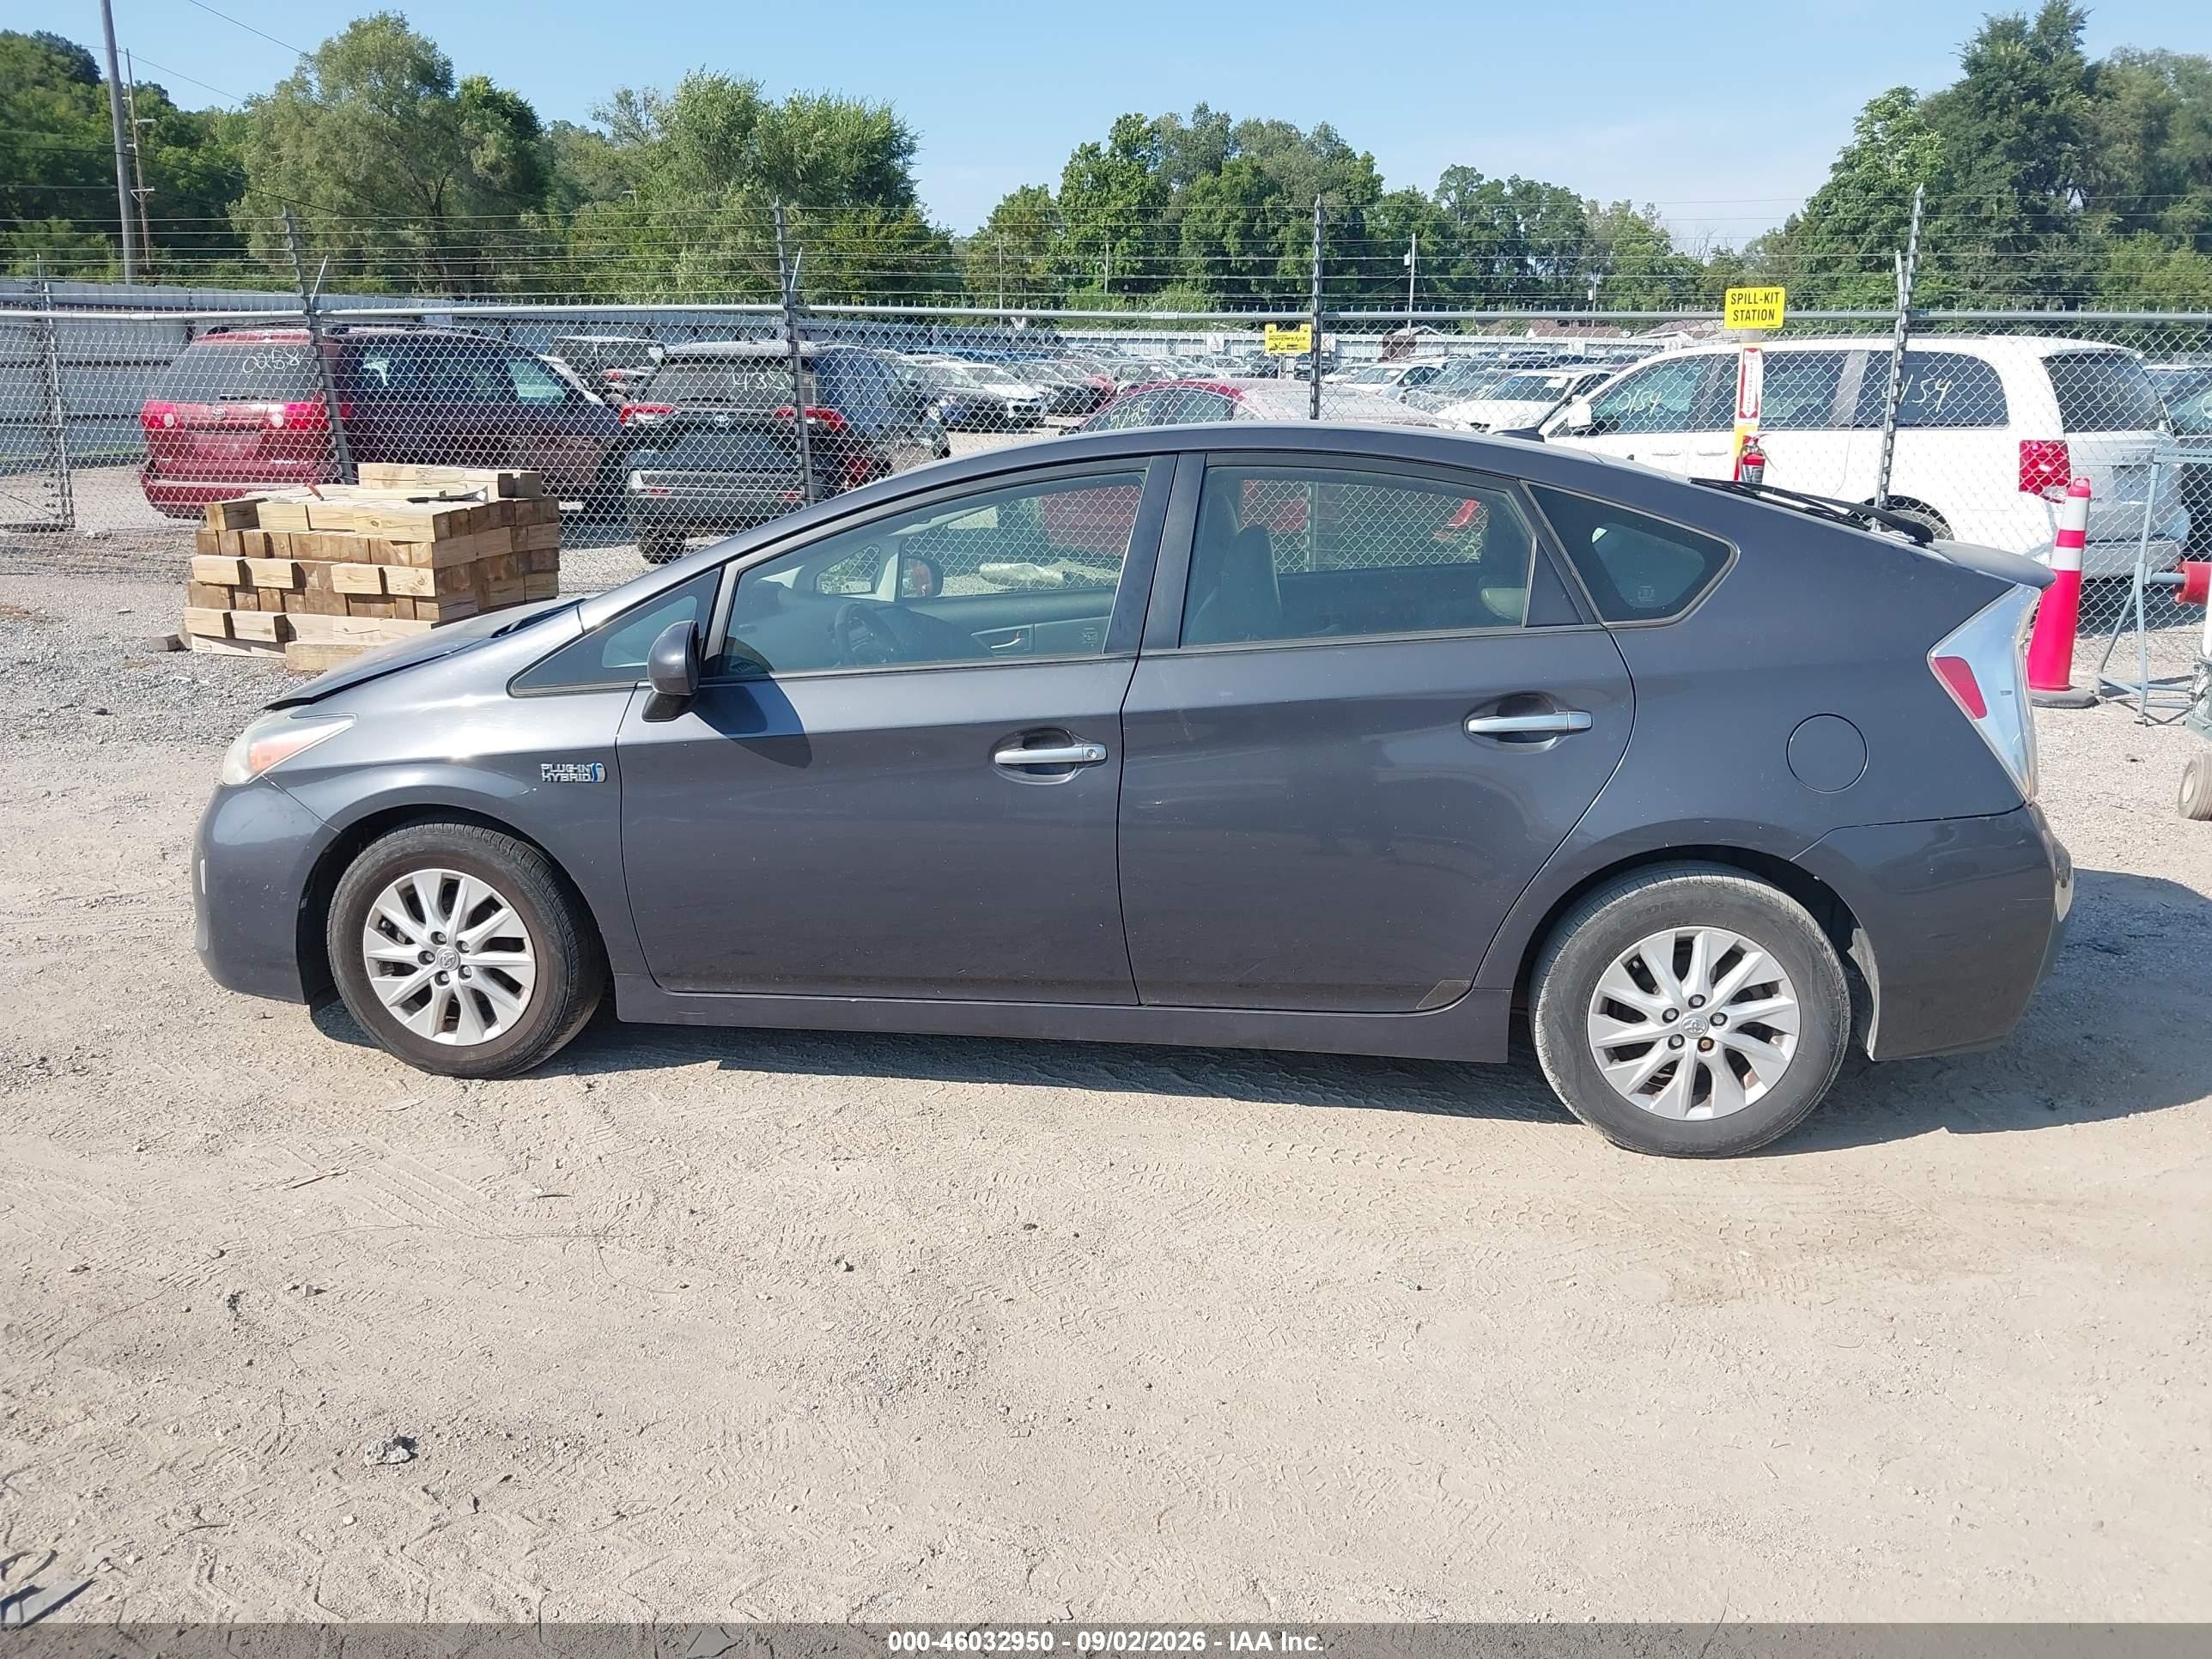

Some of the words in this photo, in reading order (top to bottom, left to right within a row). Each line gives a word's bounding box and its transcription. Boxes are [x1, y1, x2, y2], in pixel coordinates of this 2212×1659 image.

[1730, 291, 1781, 306] SPILL-KIT
[1732, 308, 1776, 322] STATION
[540, 763, 592, 774] PLUG-IN
[541, 773, 592, 782] HYBRID
